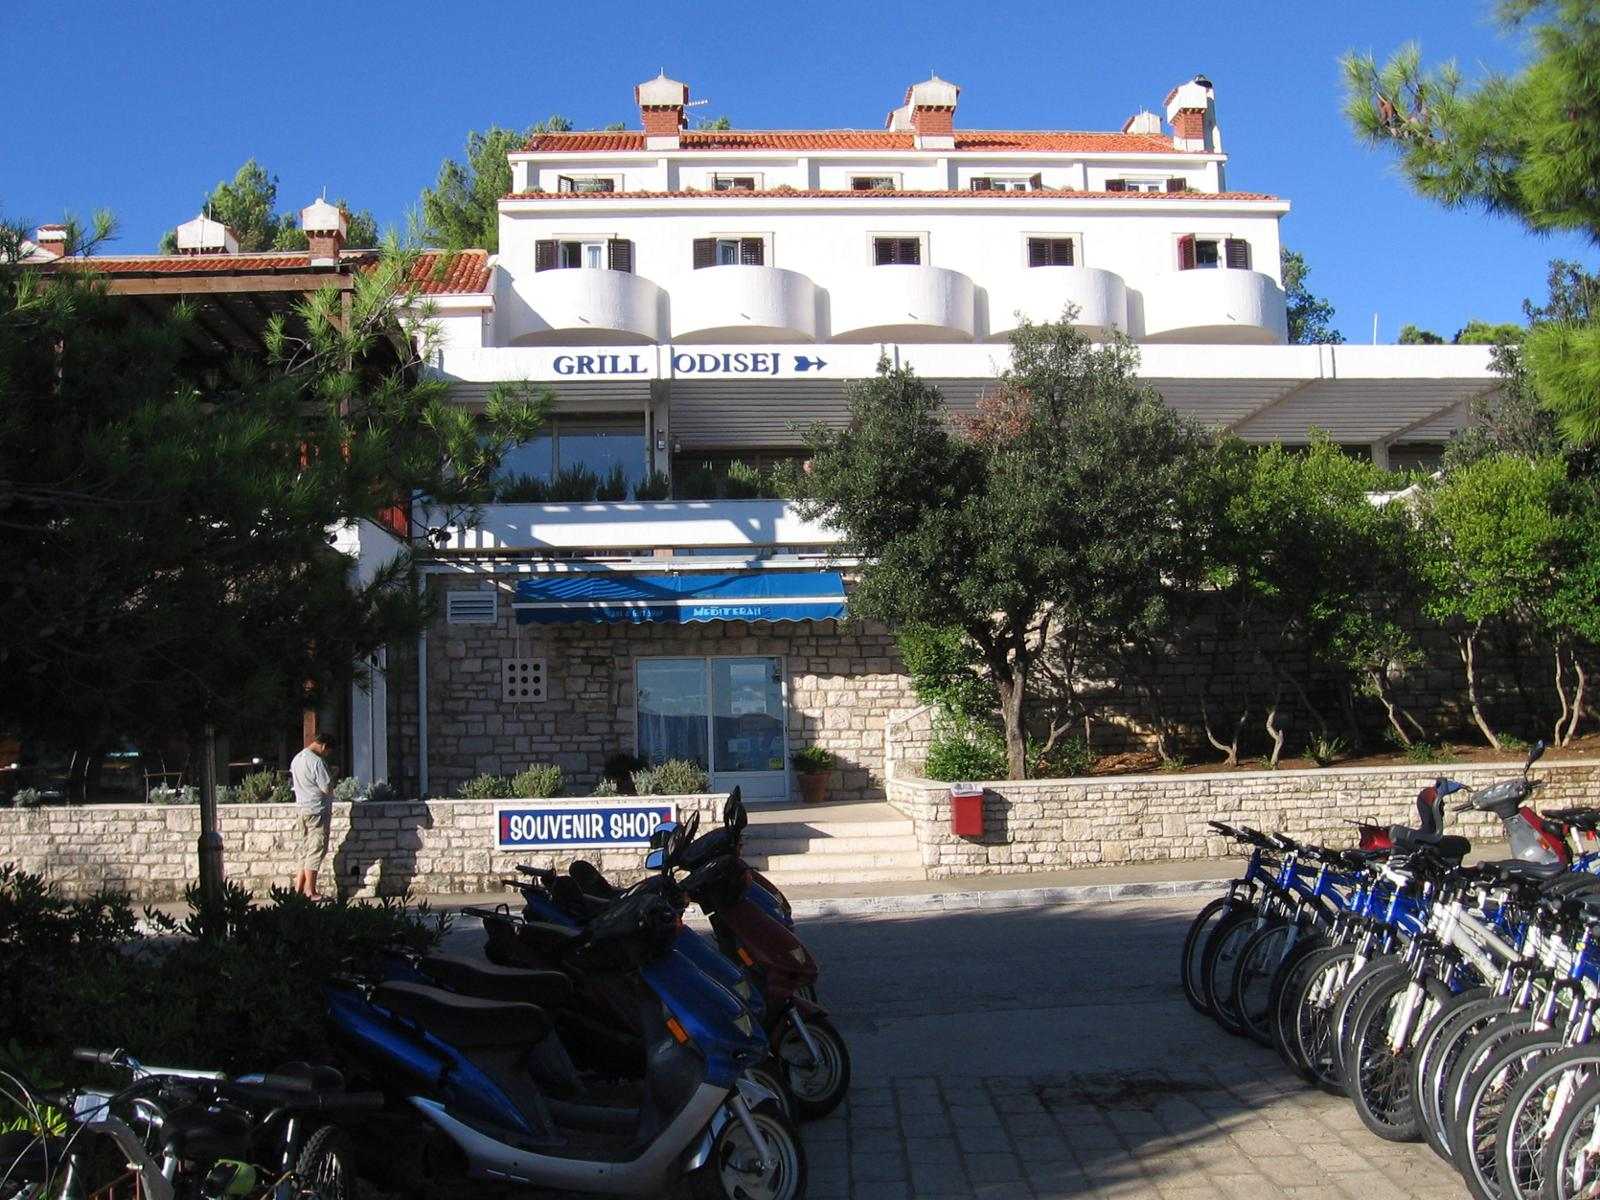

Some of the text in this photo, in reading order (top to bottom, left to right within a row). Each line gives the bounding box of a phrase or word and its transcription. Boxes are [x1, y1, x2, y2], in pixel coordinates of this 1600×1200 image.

[553, 353, 781, 375] GRILL ODISEJ
[510, 812, 661, 841] SOUVENIR SHOP
